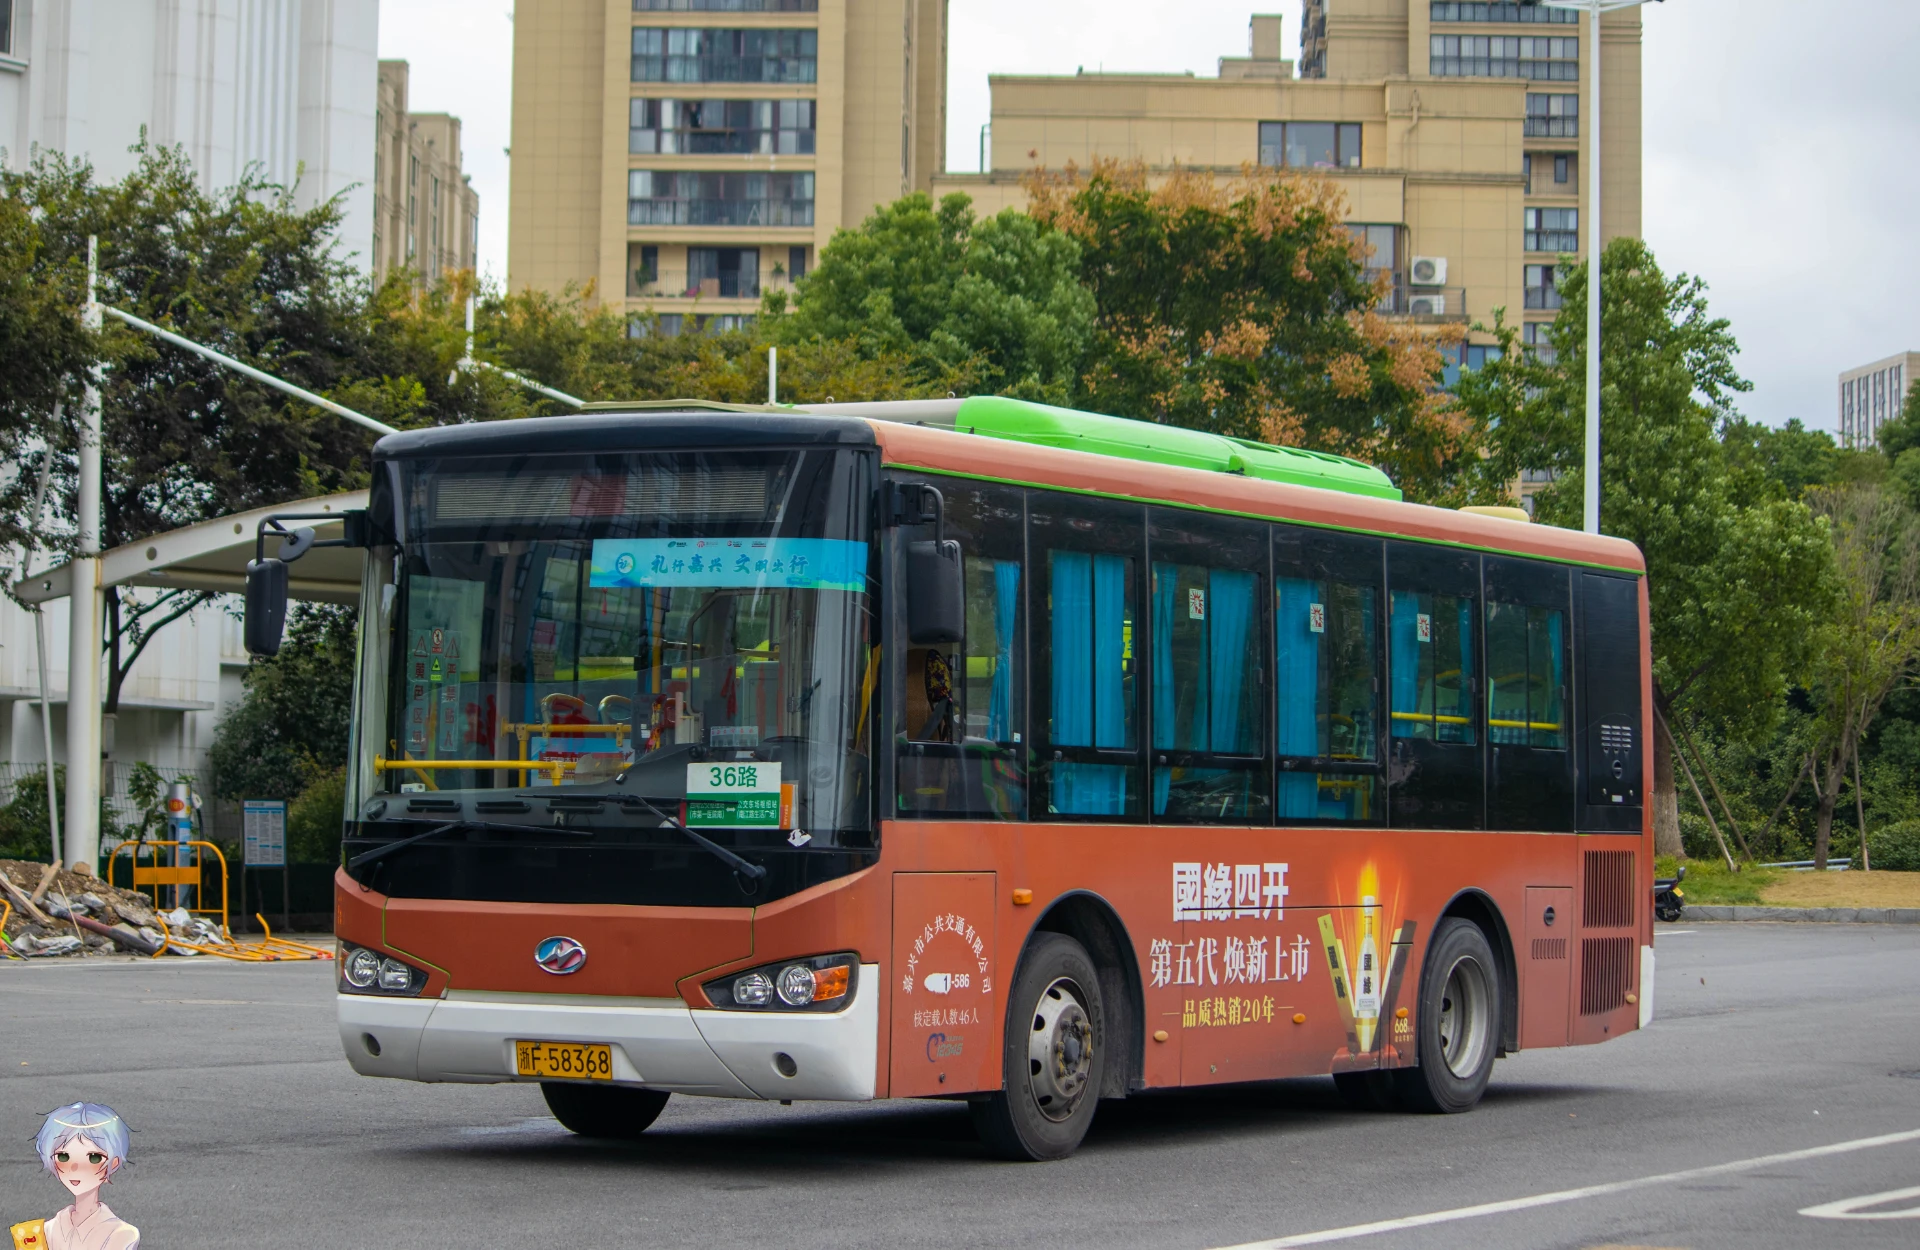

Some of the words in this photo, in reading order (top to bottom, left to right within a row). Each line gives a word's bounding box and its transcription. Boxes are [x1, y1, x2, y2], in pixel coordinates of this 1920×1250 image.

[651, 553, 722, 574] 礼行嘉兴
[733, 553, 809, 575] 文明出行
[709, 765, 757, 788] 36路
[902, 912, 992, 995] 嘉兴市公共交通有限公司
[1149, 938, 1218, 988] 第五代
[1223, 934, 1311, 985] 焕新上市
[914, 1007, 979, 1028] 核定载人数46人
[1182, 995, 1275, 1028] 品质热销20年
[1395, 1018, 1408, 1034] 668
